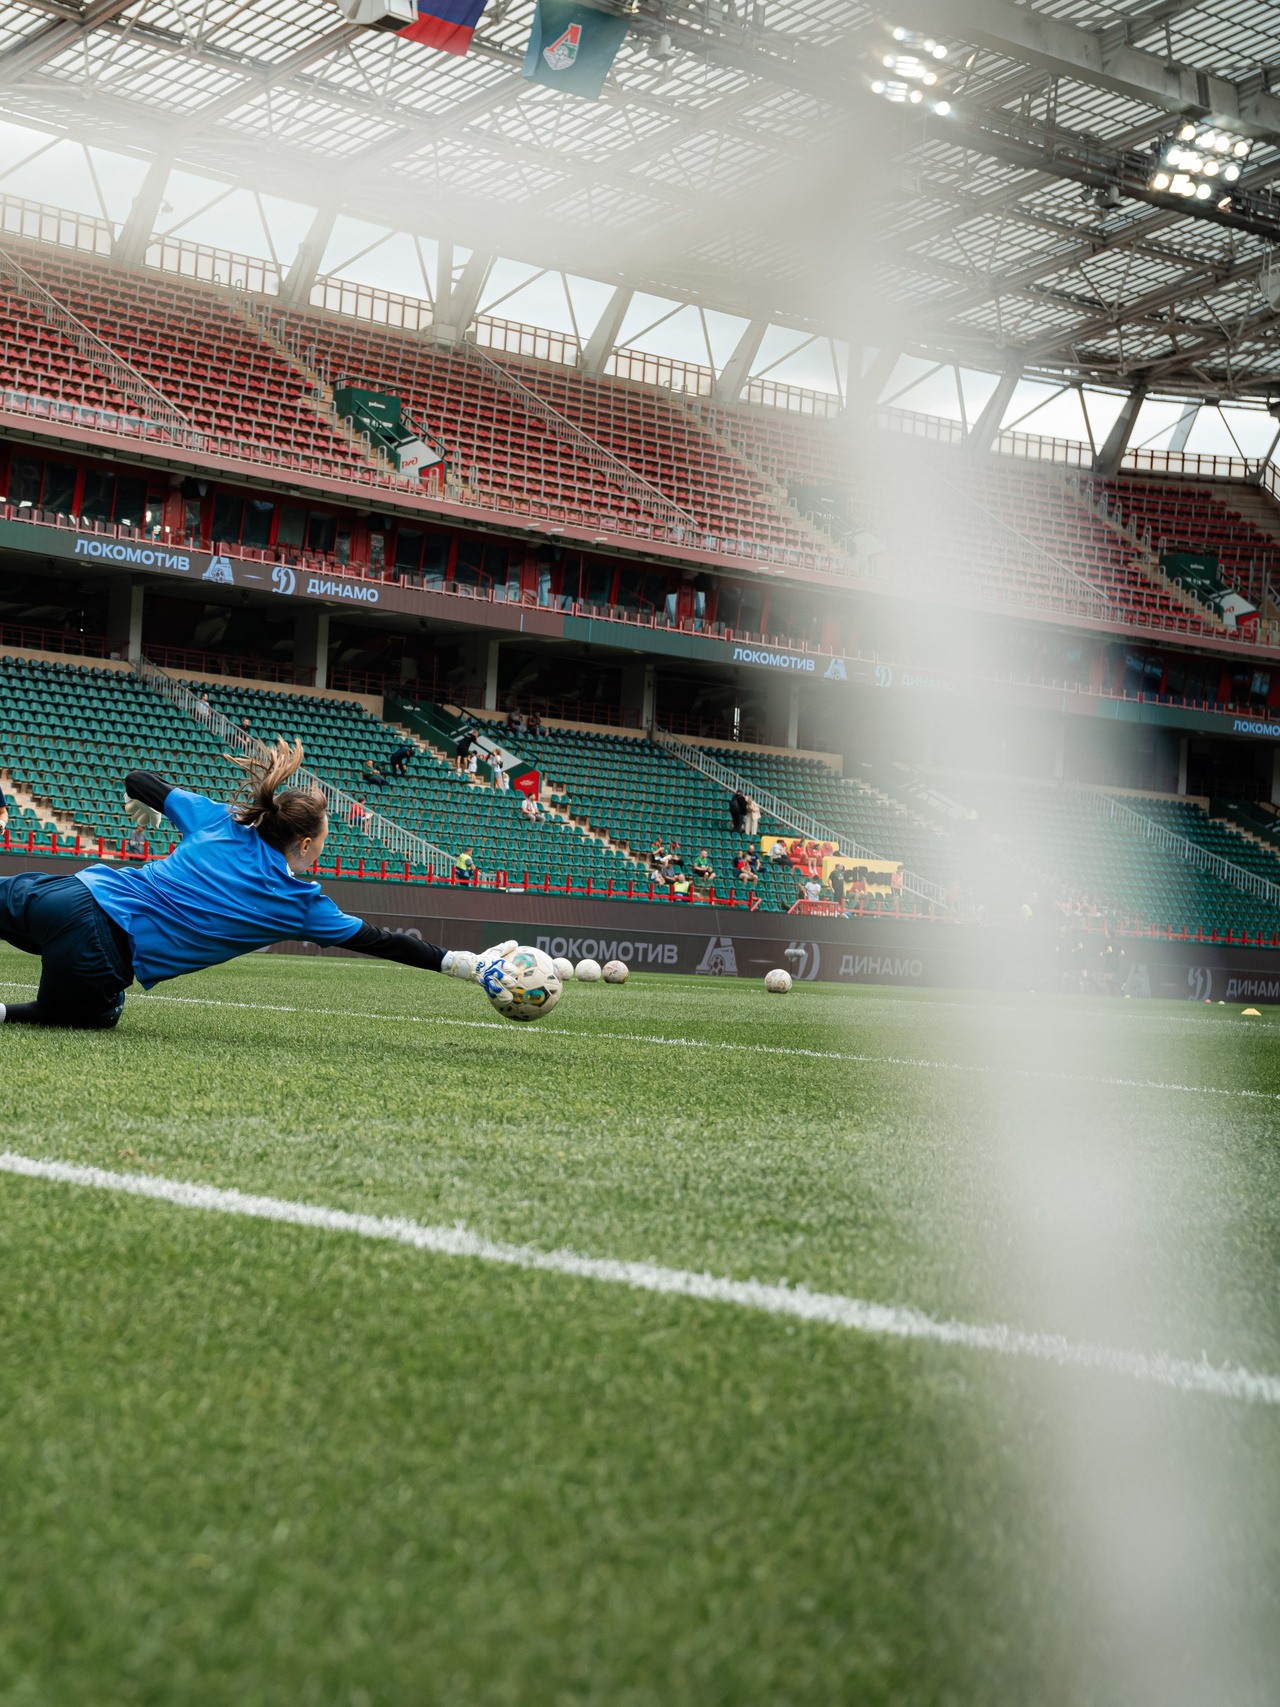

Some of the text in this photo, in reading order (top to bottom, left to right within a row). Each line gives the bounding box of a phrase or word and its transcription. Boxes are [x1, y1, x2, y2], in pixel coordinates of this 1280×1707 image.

[75, 538, 379, 602] ЛОКОМОТИВ ДИНАМО
[733, 648, 815, 671] ЛОКОМОТИВ
[1233, 720, 1280, 736] ЛОКОМО
[536, 936, 678, 964] ЛОКОМОТИВ
[839, 954, 923, 978] ДИНАМО
[1226, 978, 1280, 998] ДИНАМ
